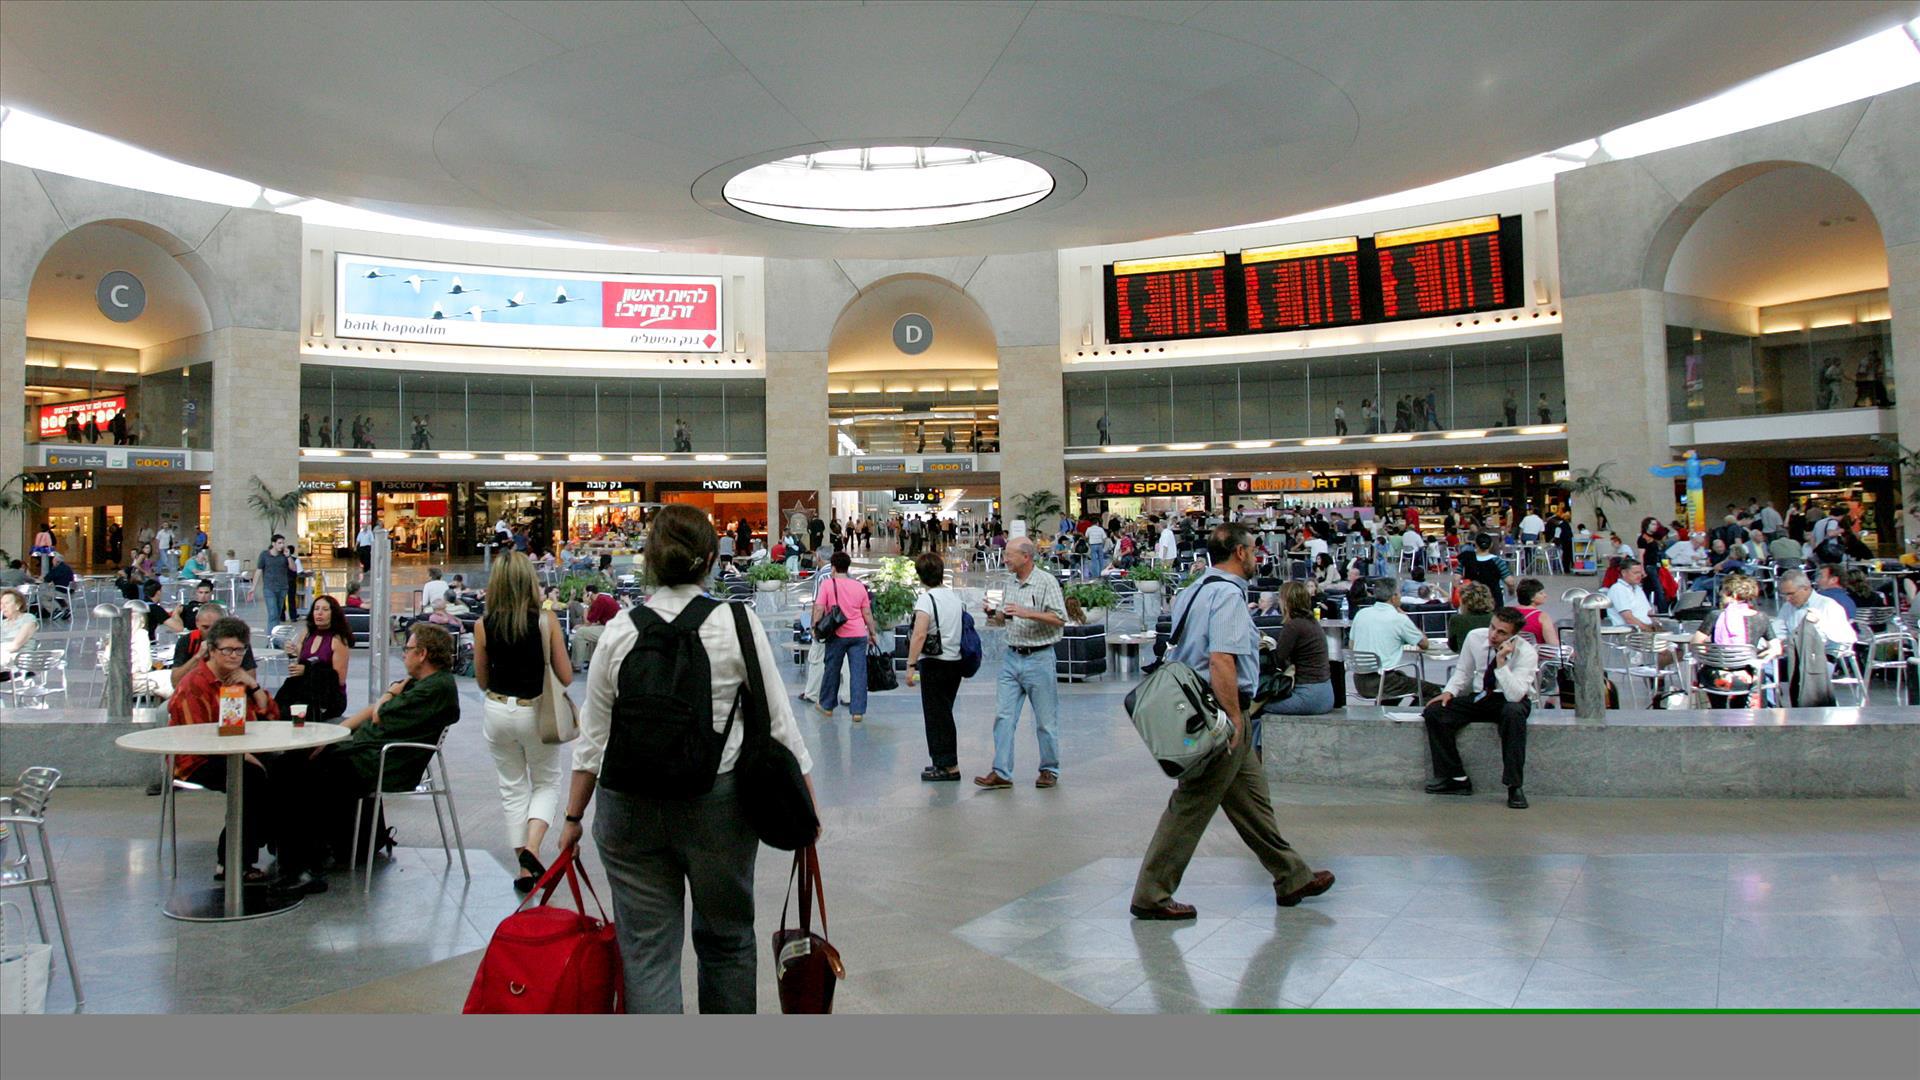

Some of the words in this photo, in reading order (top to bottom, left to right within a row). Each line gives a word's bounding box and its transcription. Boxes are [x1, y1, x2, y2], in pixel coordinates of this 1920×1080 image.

[111, 285, 129, 308] C
[623, 288, 665, 303] ראשון
[665, 288, 708, 303] להיות
[672, 304, 695, 318] זה
[344, 318, 379, 331] bank
[383, 320, 447, 336] hapoalim
[906, 325, 923, 343] D
[630, 333, 677, 345] הפועלים
[680, 335, 700, 346] בנק
[298, 480, 336, 489] Watches
[1133, 482, 1194, 493] SPORT
[898, 493, 908, 501] D1
[914, 493, 925, 501] D9
